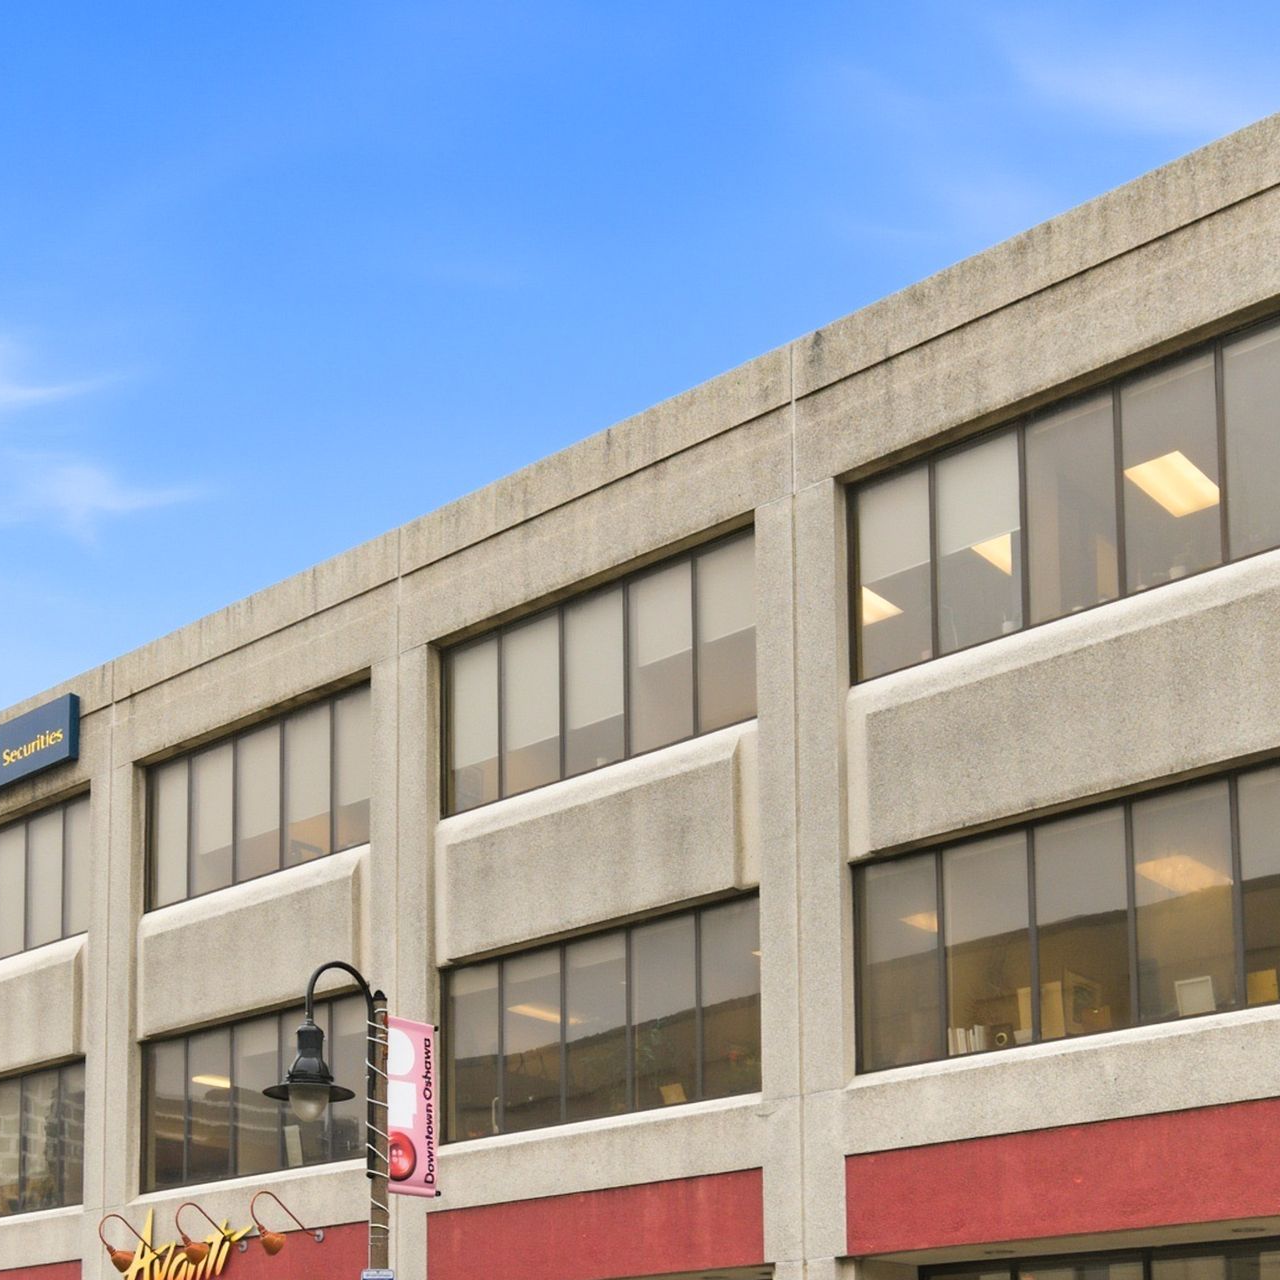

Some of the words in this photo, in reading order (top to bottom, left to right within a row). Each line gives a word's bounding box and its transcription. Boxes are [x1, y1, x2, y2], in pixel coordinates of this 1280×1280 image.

[2, 729, 64, 766] Securities
[422, 1038, 433, 1100] Oshawa
[424, 1104, 435, 1184] Downtown
